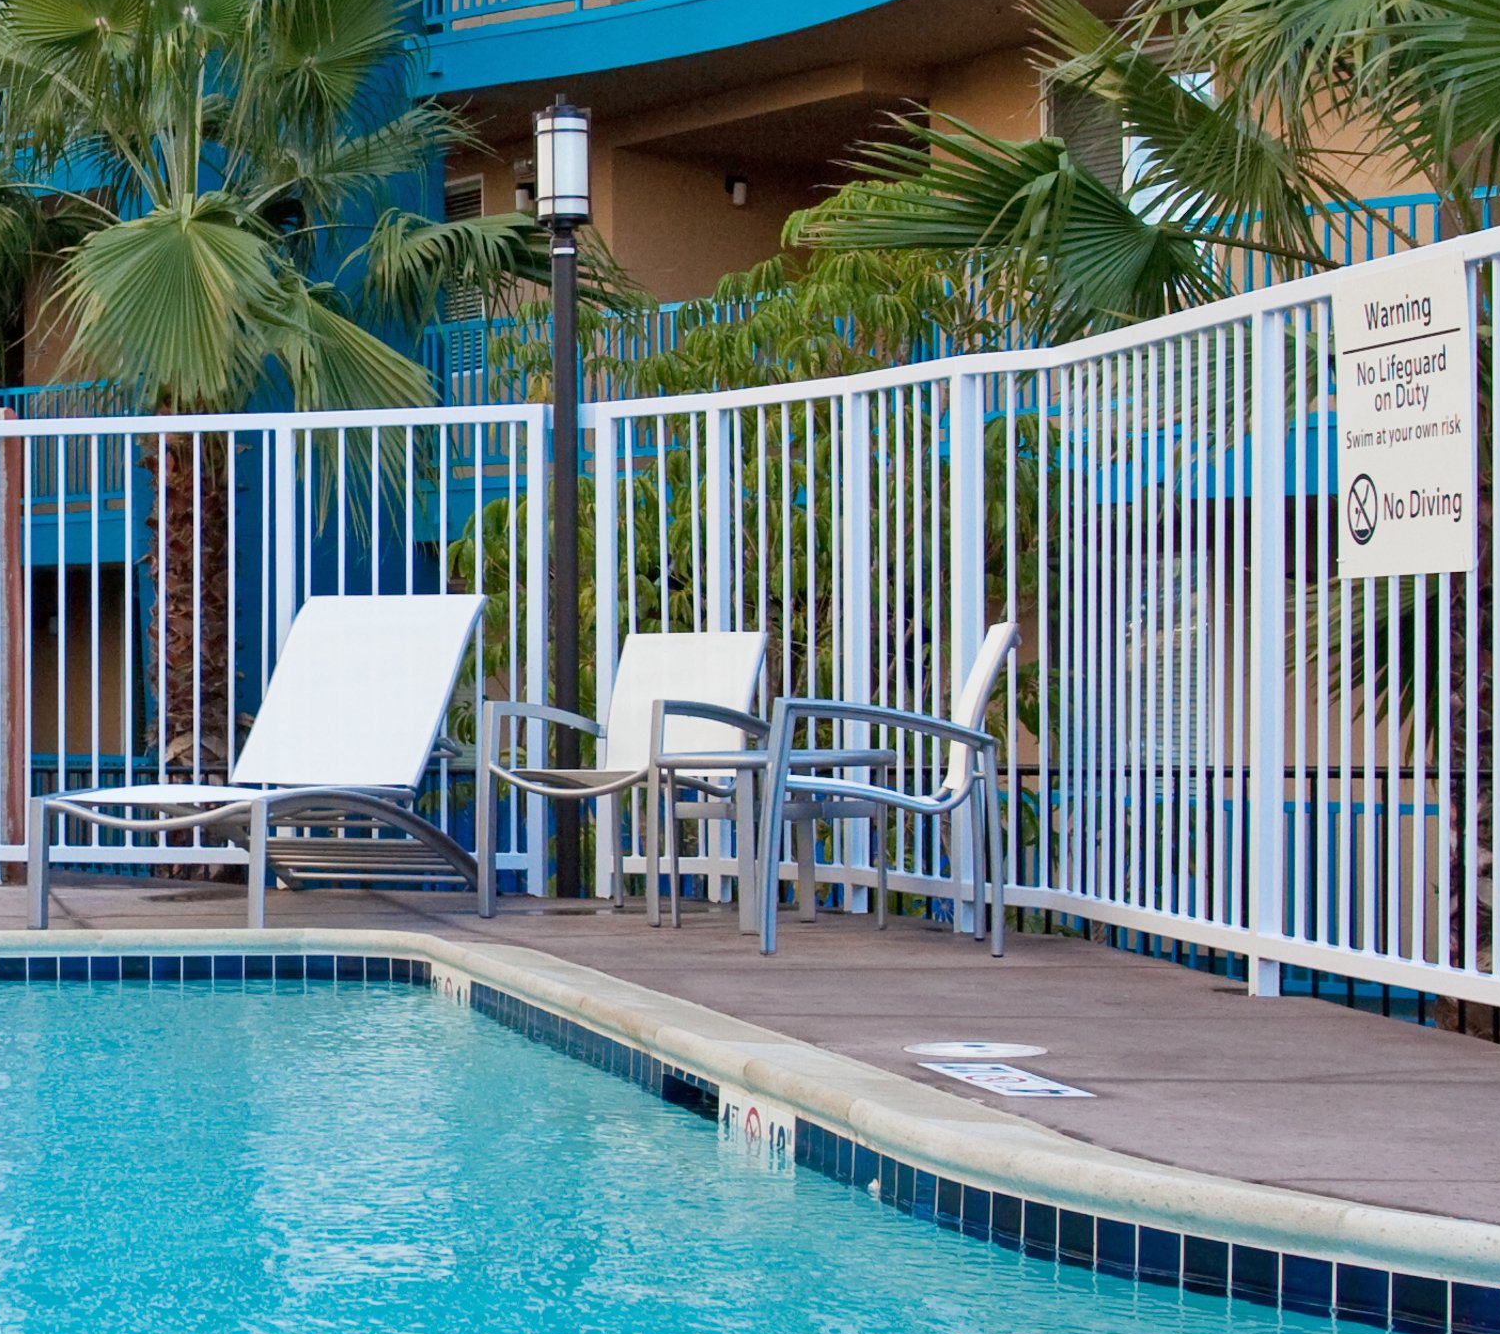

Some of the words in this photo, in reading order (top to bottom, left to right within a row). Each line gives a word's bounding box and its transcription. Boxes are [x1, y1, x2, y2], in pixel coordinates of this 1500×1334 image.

[1364, 293, 1432, 331] Warning
[1357, 361, 1376, 387] No
[1379, 343, 1447, 385] Lifeguard
[1374, 391, 1392, 412] on
[1396, 383, 1429, 412] Duty
[1346, 429, 1374, 450] Swim
[1376, 428, 1387, 446] at
[1389, 425, 1413, 449] your
[1415, 422, 1439, 440] own
[1441, 413, 1462, 436] risk
[1383, 492, 1405, 520] No
[1410, 486, 1463, 523] Diving
